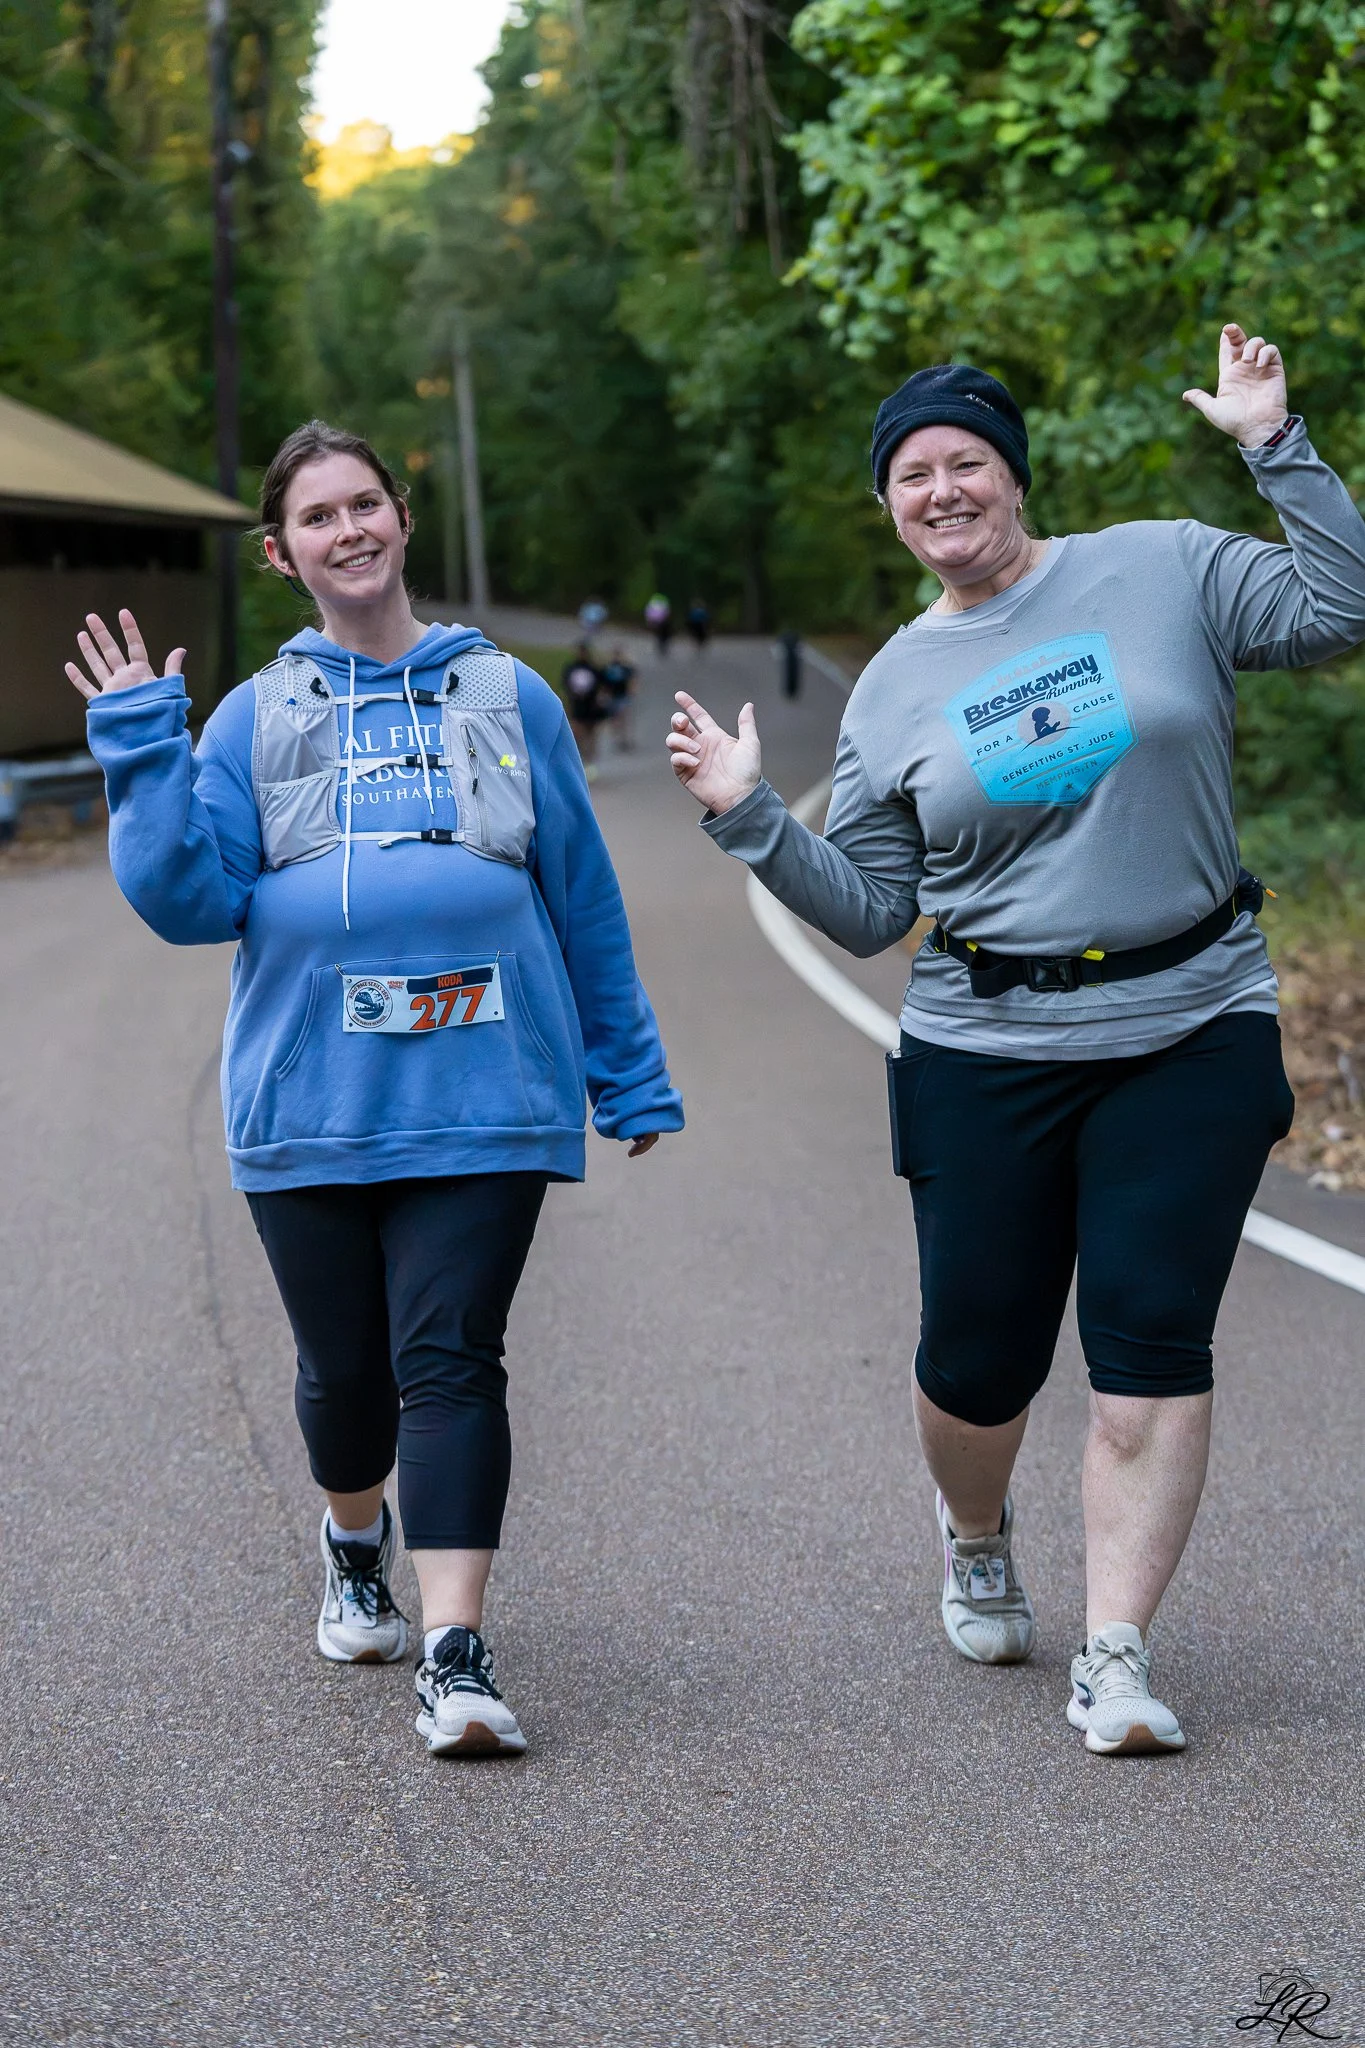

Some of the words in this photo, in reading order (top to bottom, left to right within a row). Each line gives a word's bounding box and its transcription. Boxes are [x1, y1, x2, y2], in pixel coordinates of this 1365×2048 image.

[963, 654, 1099, 725] Breakaway
[1045, 673, 1105, 700] Running
[339, 729, 381, 754] AL
[976, 740, 1000, 757] FOR
[1005, 735, 1014, 743] A
[1073, 693, 1116, 713] CAUSE
[1002, 751, 1064, 783] BENEFITING
[1067, 744, 1084, 754] ST.
[1088, 731, 1116, 747] JUDE
[437, 973, 463, 989] KODA
[409, 985, 487, 1031] 277
